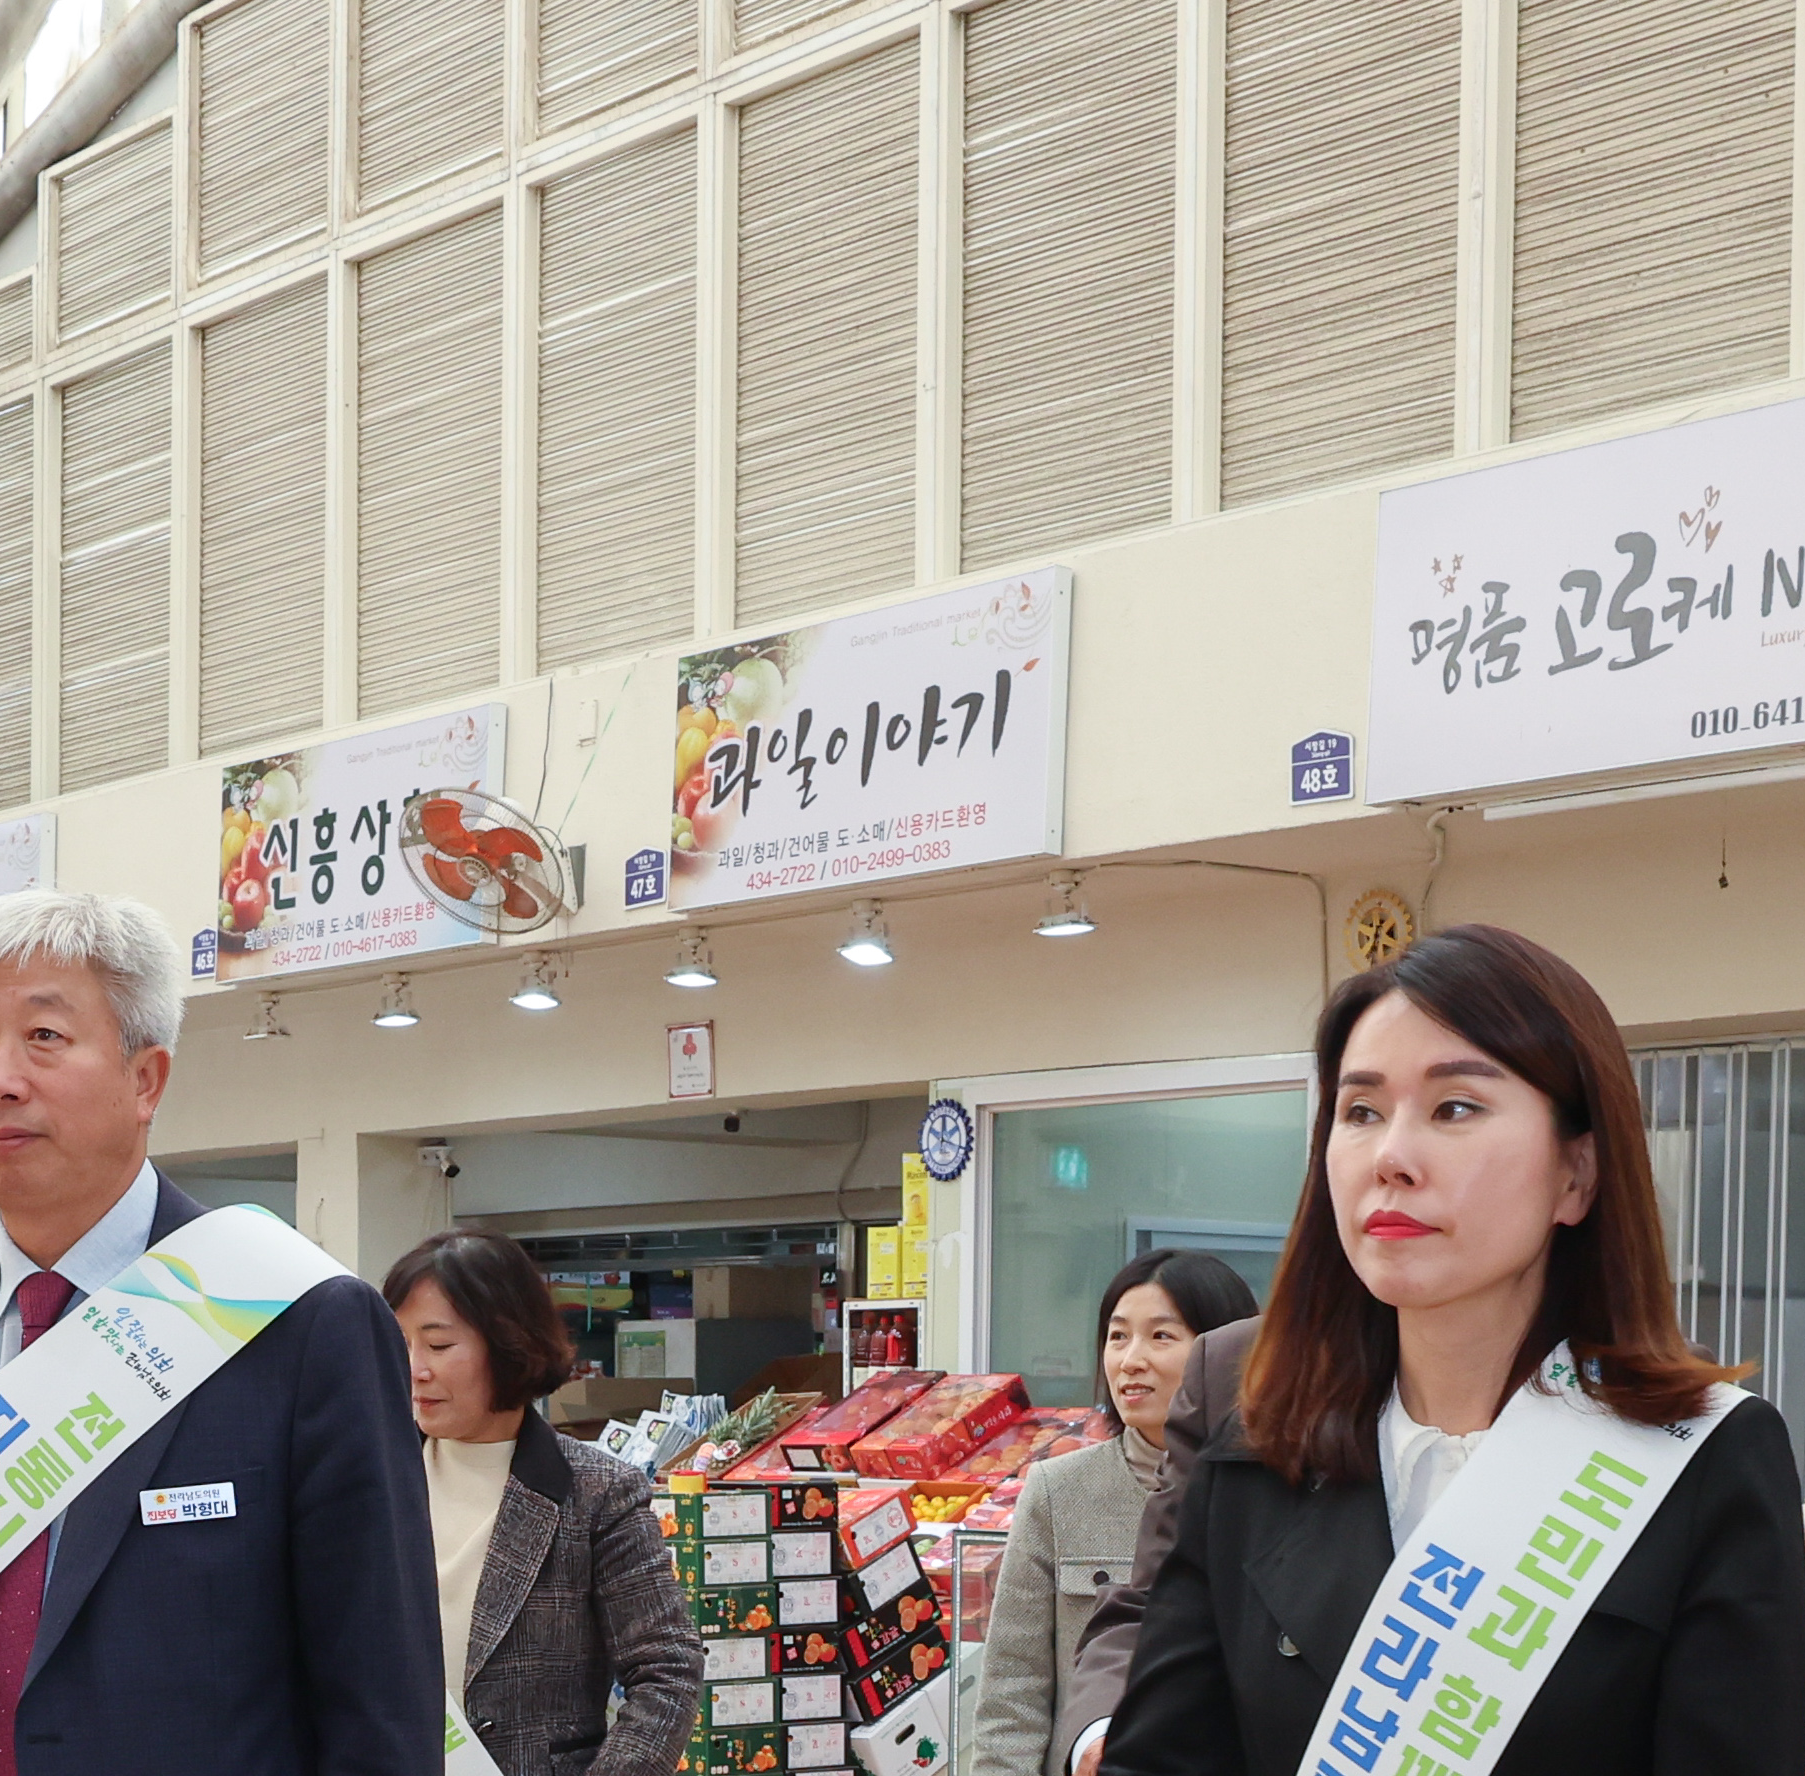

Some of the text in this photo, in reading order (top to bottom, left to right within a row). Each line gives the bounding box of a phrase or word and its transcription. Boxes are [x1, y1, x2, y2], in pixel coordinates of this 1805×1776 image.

[850, 606, 982, 649] Gangjin Traditional market
[1408, 581, 1527, 695] 명품
[1548, 531, 1734, 677] 고로케
[708, 669, 1012, 817] 과일이야기
[1300, 764, 1339, 794] 48호
[262, 787, 422, 912] 신흥상
[717, 830, 831, 869] 과일/청과/건어물
[745, 863, 815, 891] 434-2722
[831, 839, 952, 877] 010-2499-0383
[630, 874, 656, 899] 47호
[272, 945, 321, 967] 434-2722
[332, 930, 417, 959] 010-4617-0383
[125, 1352, 172, 1402] 전라남도의회
[146, 1347, 174, 1374] 의회
[147, 1500, 229, 1520] 진보당 박형대
[168, 1488, 221, 1503] 전라남도의원
[1466, 1447, 1648, 1674] 도민과
